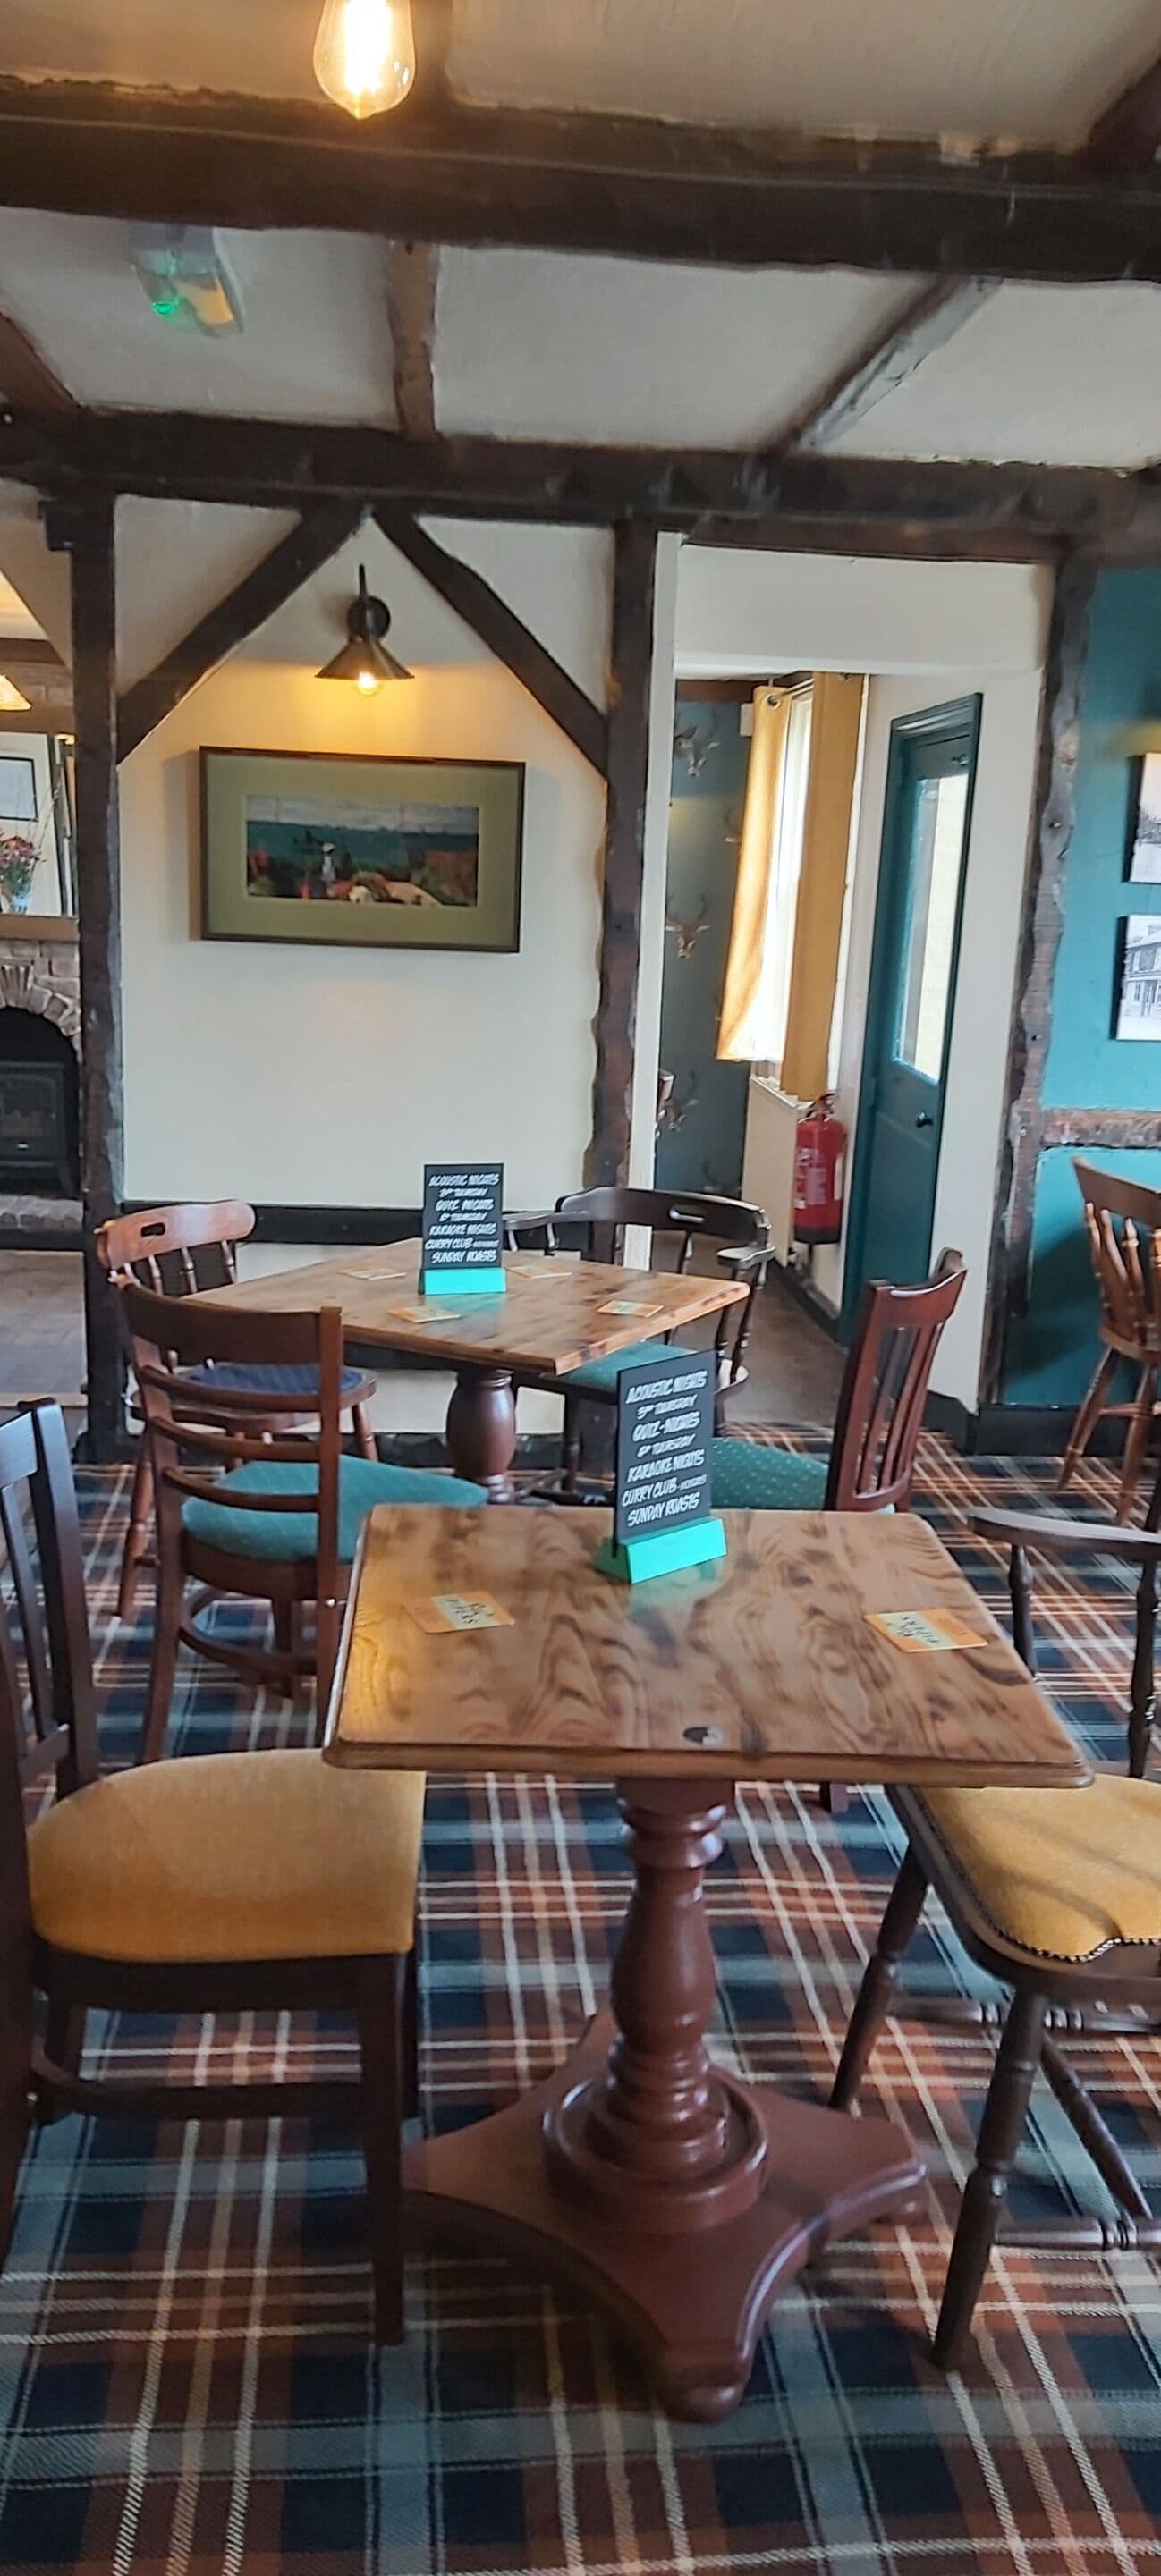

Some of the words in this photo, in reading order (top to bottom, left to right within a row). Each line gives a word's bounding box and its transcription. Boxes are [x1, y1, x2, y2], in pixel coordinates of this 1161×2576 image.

[436, 1199, 460, 1211] QUIZ
[428, 1223, 467, 1236] KARAOKE
[425, 1238, 453, 1250] CURRY
[452, 1237, 474, 1249] CLUB
[431, 1251, 465, 1263] SUNDAY
[466, 1250, 497, 1263] ROASTS
[625, 1378, 674, 1404] ACOUSTIC
[626, 1457, 673, 1482] KARAOKE
[673, 1448, 705, 1471] NIGHTS
[622, 1483, 654, 1507] CURRY
[652, 1477, 678, 1498] CLUB
[627, 1500, 666, 1527] SUNDAY
[665, 1491, 700, 1516] ROASTS
